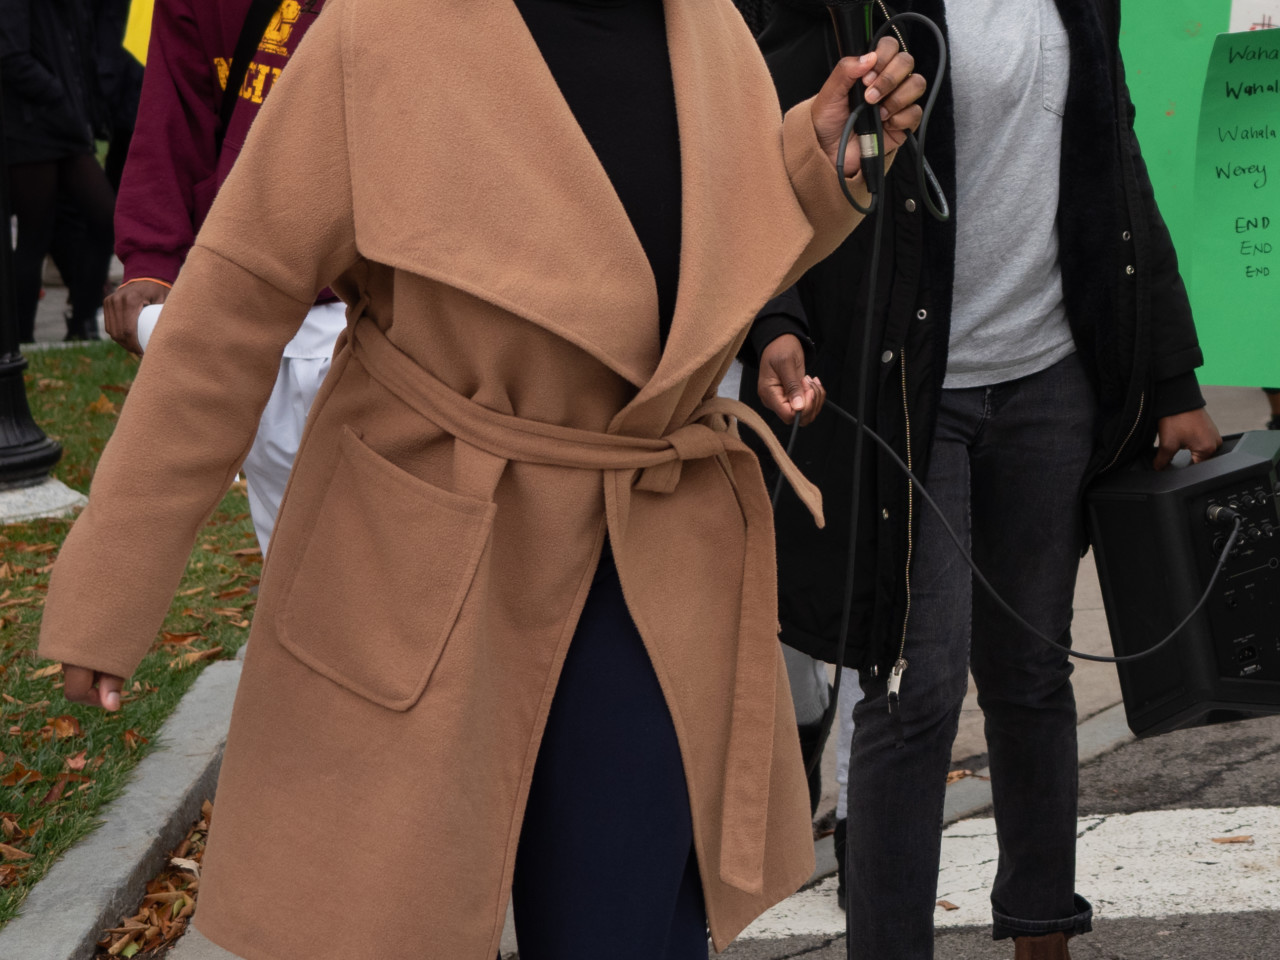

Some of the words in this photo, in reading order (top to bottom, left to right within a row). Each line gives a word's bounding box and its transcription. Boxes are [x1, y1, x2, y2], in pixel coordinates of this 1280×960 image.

[1215, 161, 1267, 189] Werey
[1235, 216, 1271, 233] END
[1240, 241, 1273, 256] END
[1245, 265, 1270, 278] END
